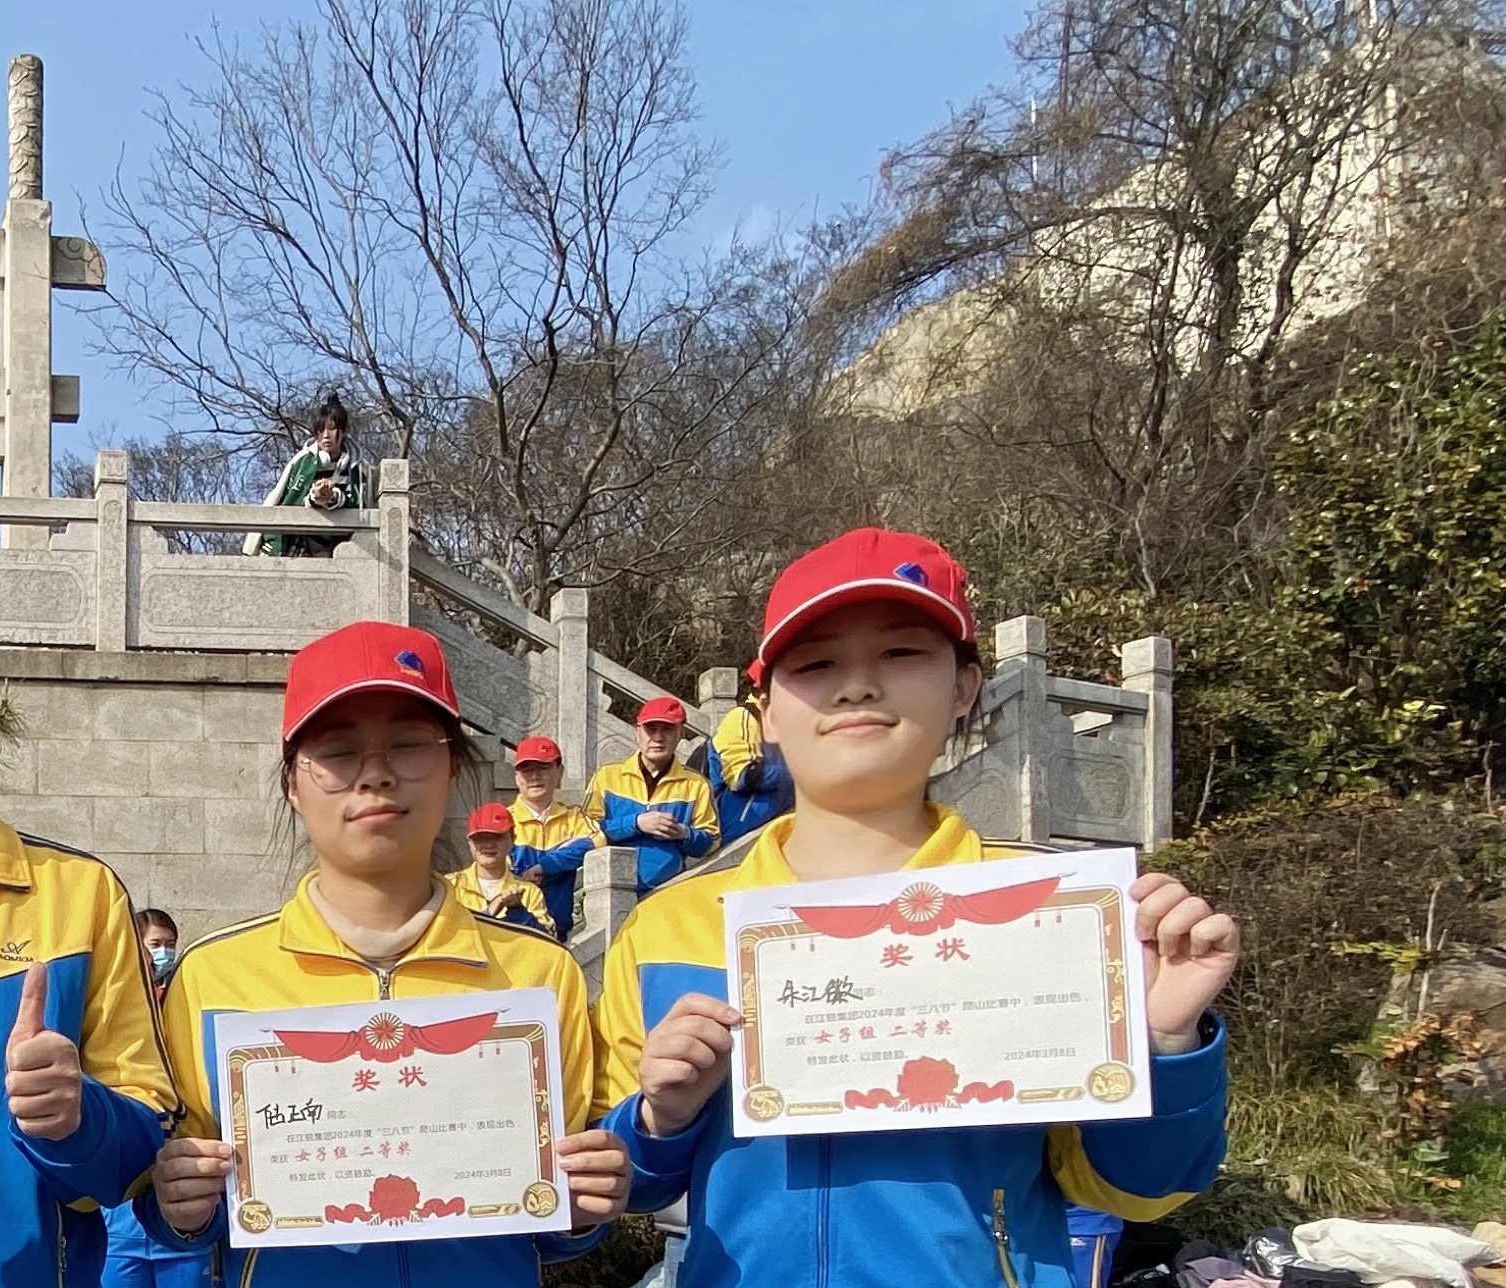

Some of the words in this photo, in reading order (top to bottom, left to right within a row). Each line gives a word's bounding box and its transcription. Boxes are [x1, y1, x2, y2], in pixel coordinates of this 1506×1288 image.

[880, 939, 970, 967] 奖状
[890, 1020, 953, 1039] 二等奖
[1004, 1047, 1076, 1061] 2024年3月8日
[352, 1066, 427, 1091] 奖状
[359, 1141, 412, 1159] 二等奖
[454, 1167, 512, 1180] 2024年3月8日
